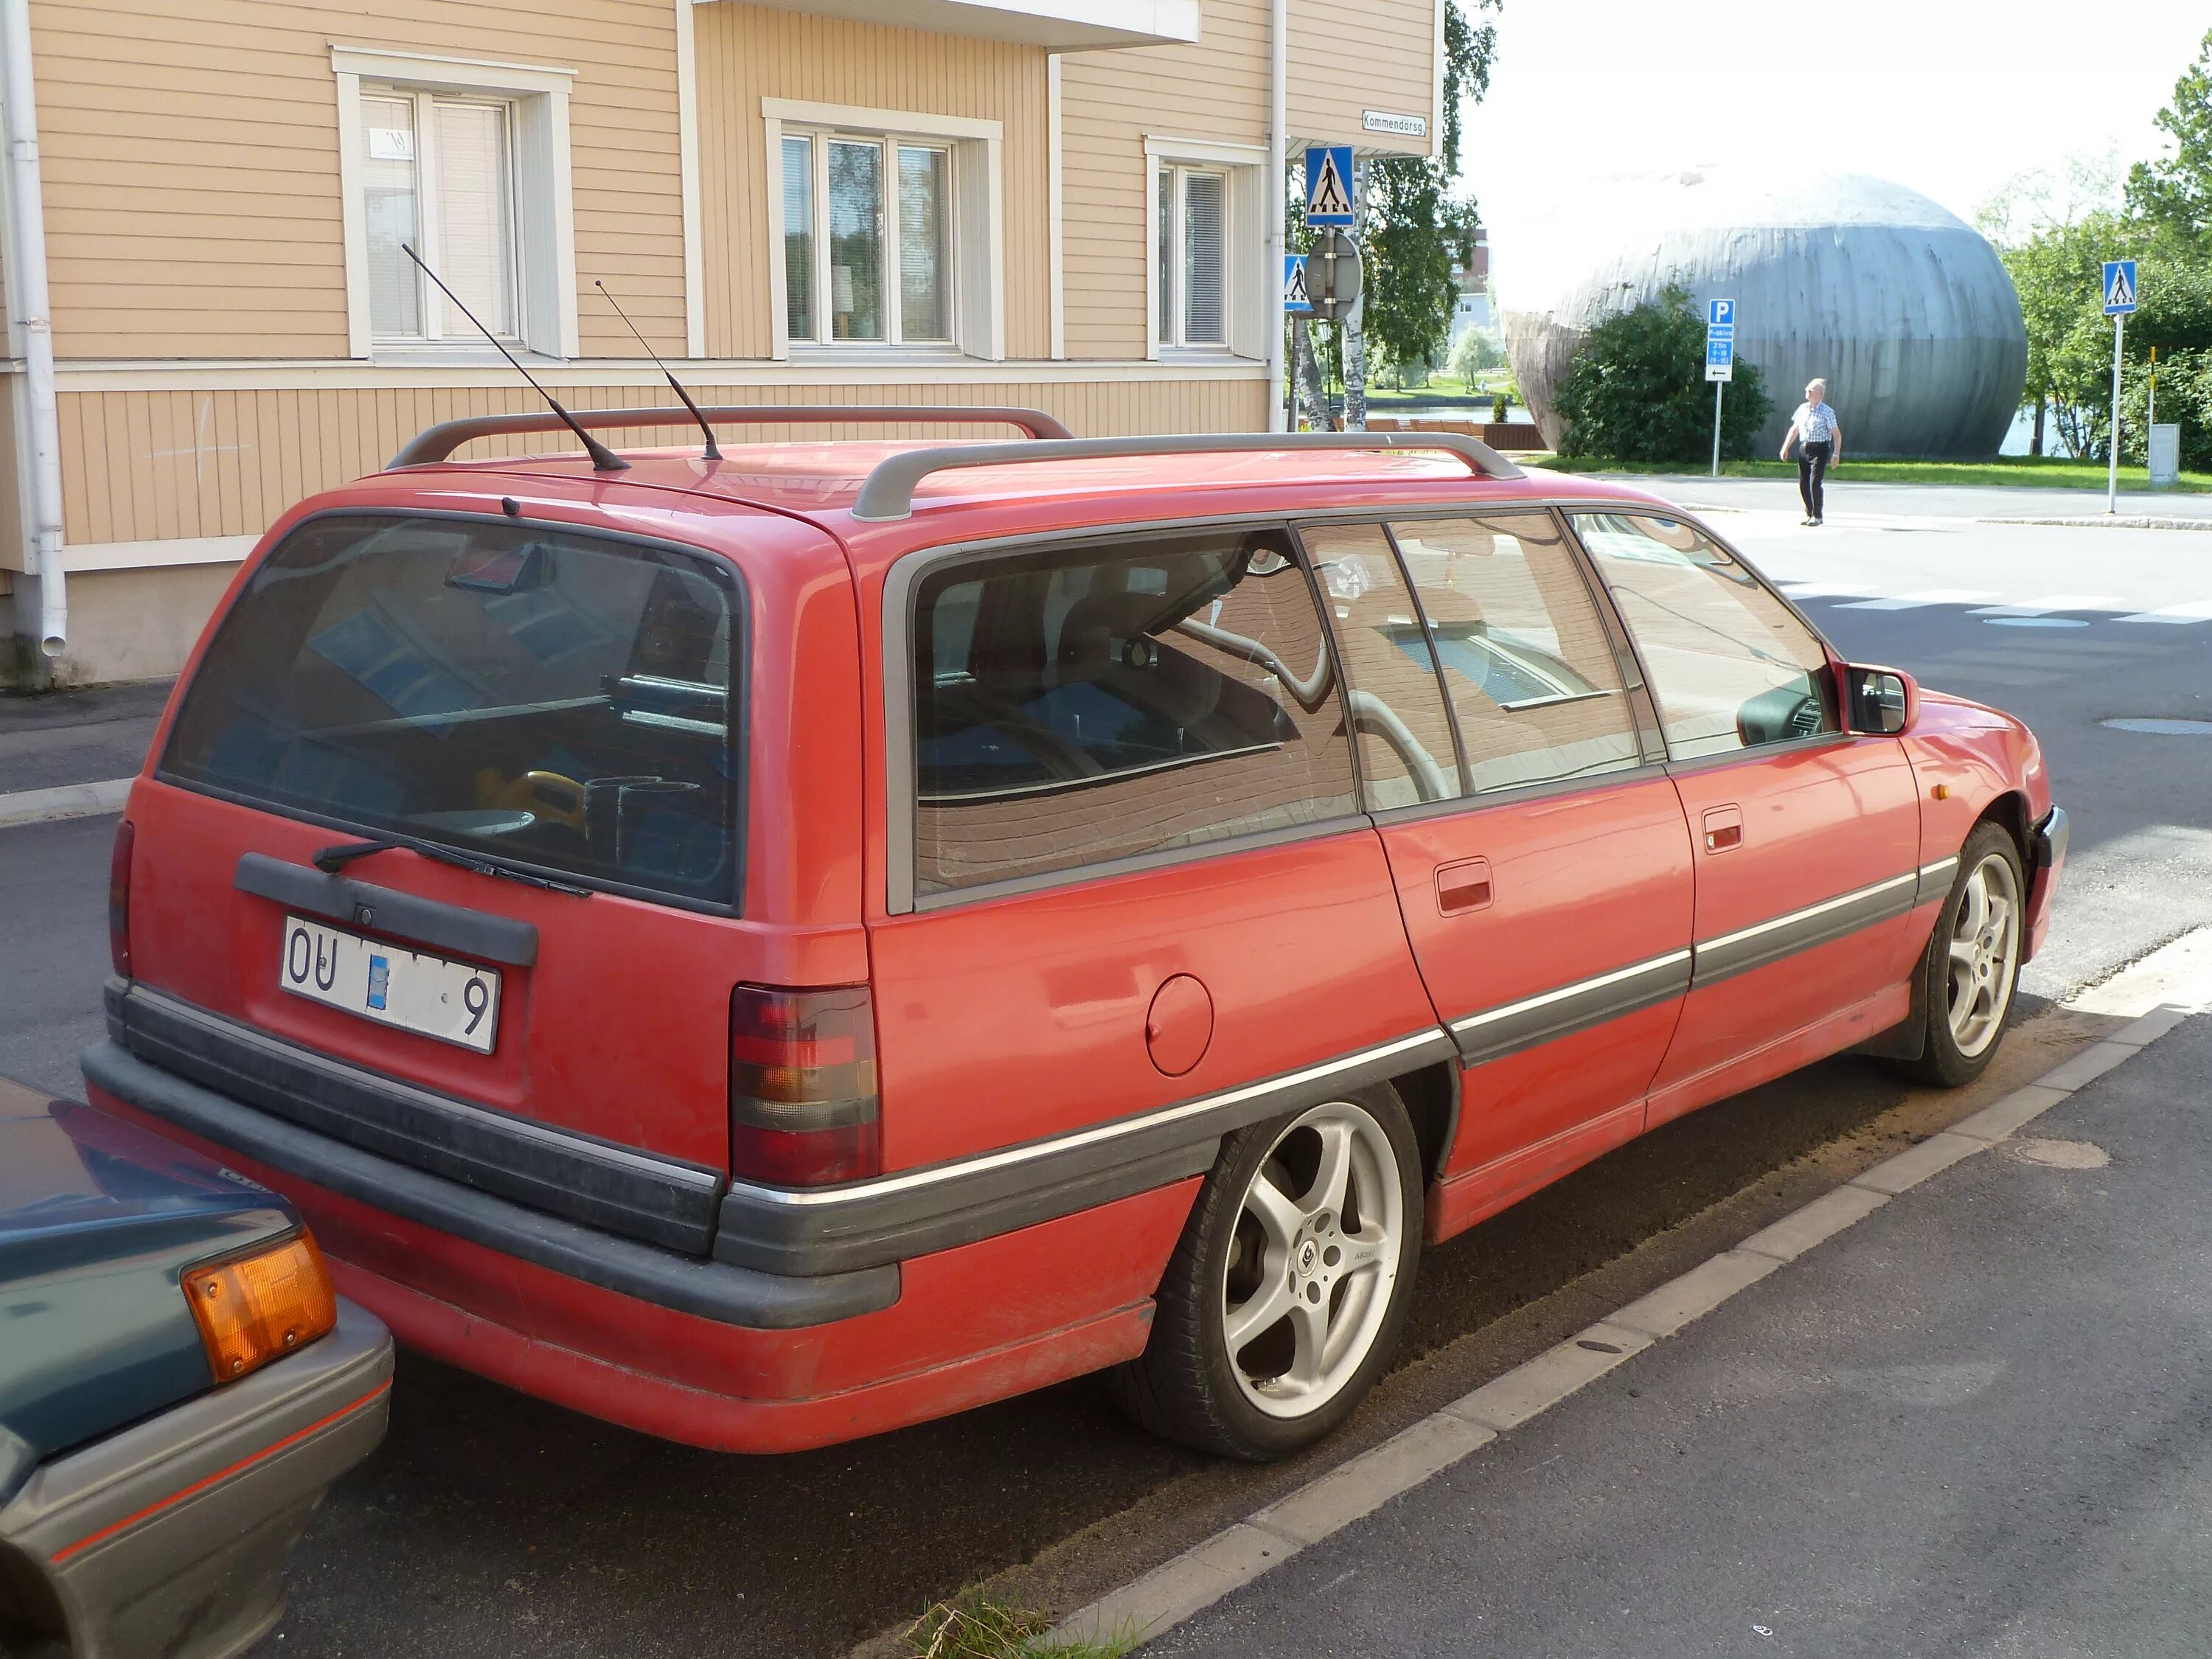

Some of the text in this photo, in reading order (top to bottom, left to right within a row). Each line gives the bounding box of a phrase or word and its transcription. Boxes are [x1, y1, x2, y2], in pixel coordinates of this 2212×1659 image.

[1716, 302, 1729, 323] P
[288, 928, 489, 1036] OU 9
